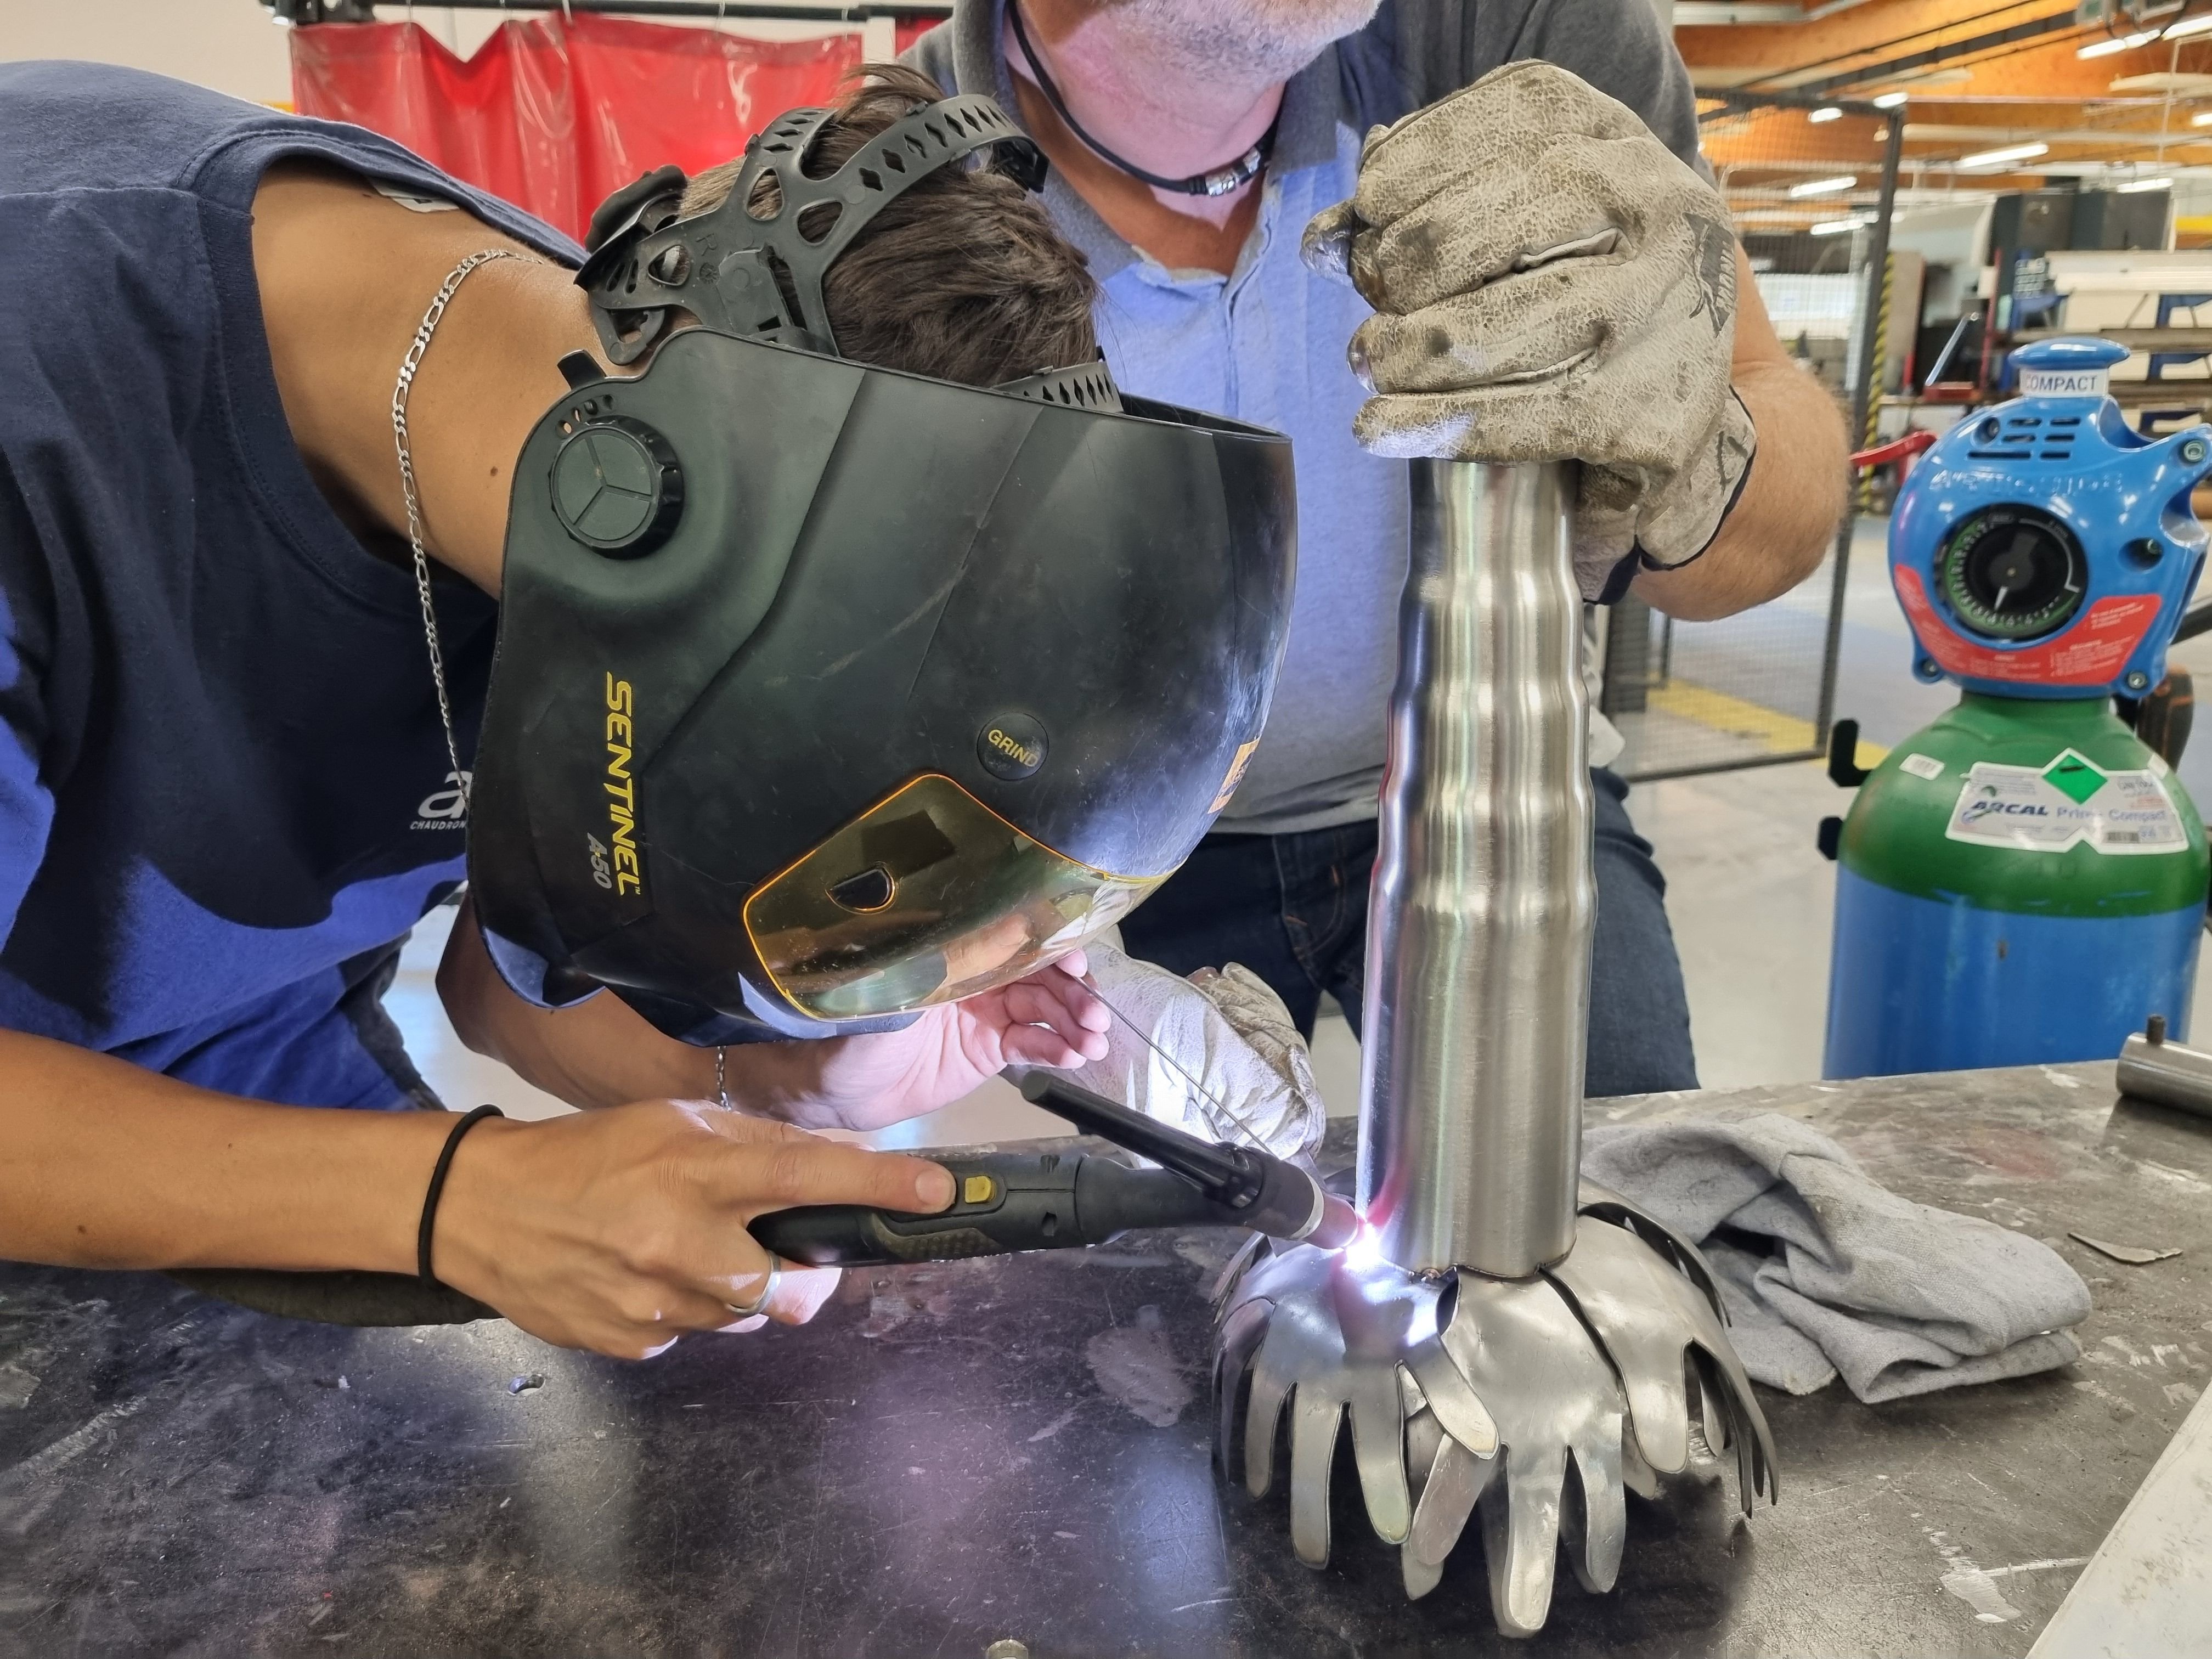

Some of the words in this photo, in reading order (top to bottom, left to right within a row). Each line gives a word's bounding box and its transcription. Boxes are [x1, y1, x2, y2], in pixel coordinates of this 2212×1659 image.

[988, 729, 1038, 767] GRIND
[603, 671, 640, 896] SENTINEL
[1973, 801, 2049, 817] ARCAL
